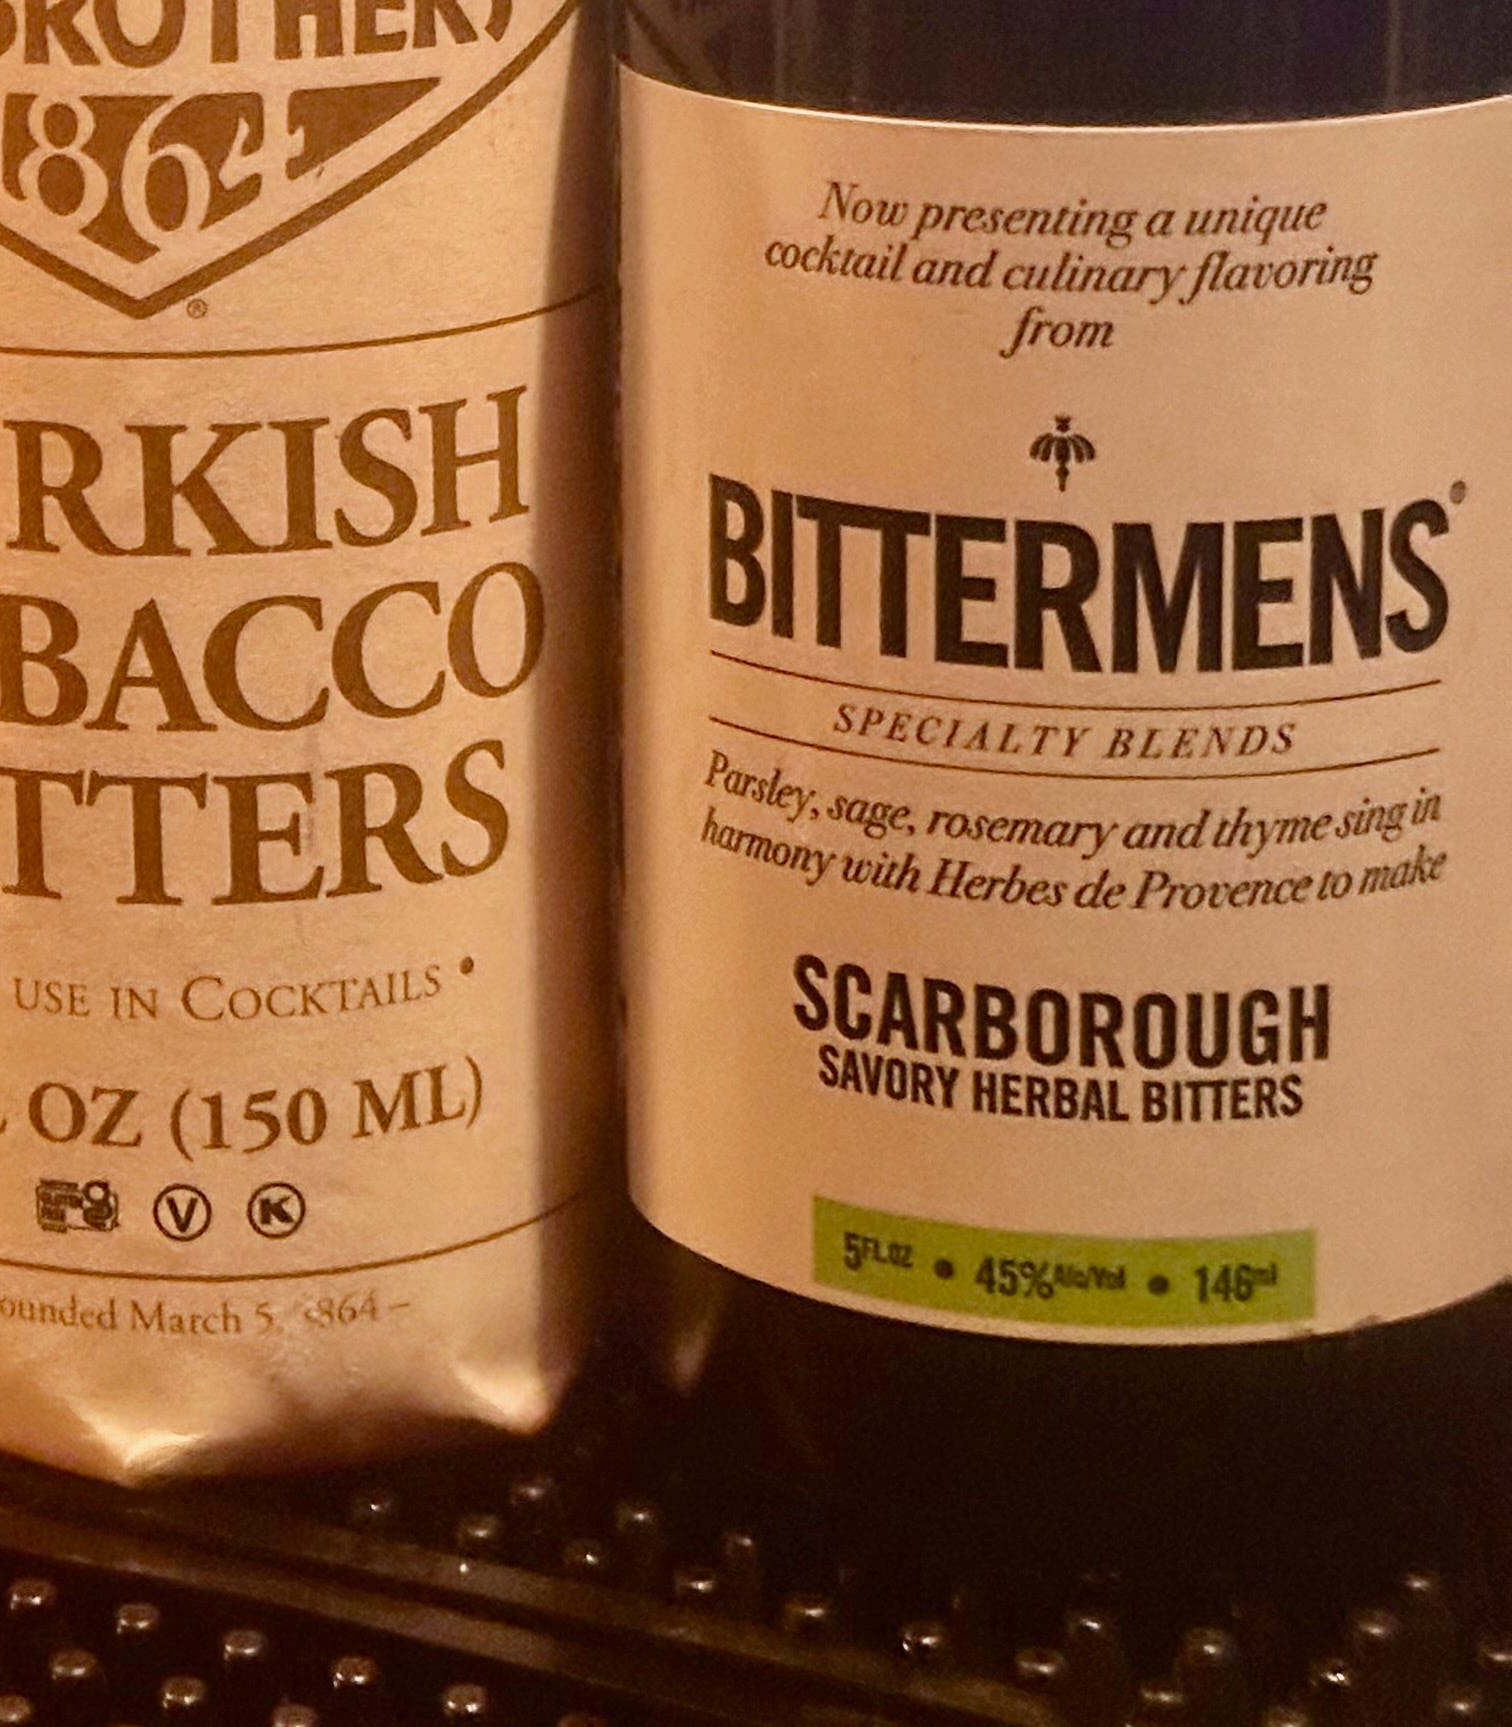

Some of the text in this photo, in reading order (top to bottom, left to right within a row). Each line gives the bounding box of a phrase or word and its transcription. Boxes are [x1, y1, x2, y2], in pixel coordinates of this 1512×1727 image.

[818, 180, 1328, 248] Now presenting a unique
[765, 235, 1379, 305] cocktail and culinary flavoring
[999, 305, 1115, 359] from
[708, 473, 1450, 673] BITTERMENS
[833, 703, 1297, 760] SPECIALTY BLENDS
[704, 749, 1443, 860] Parsley, sage, rosemary and thyme sing in
[700, 807, 1448, 910] harmony with Herbes de Provence to make
[792, 953, 1331, 1069] SCARBOROUGH
[28, 1081, 143, 1149] OZ
[169, 1086, 328, 1163] (150
[352, 1055, 484, 1141] ML)
[818, 1044, 1304, 1124] SAVORY HERBAL BITTERS
[131, 1299, 242, 1335] March
